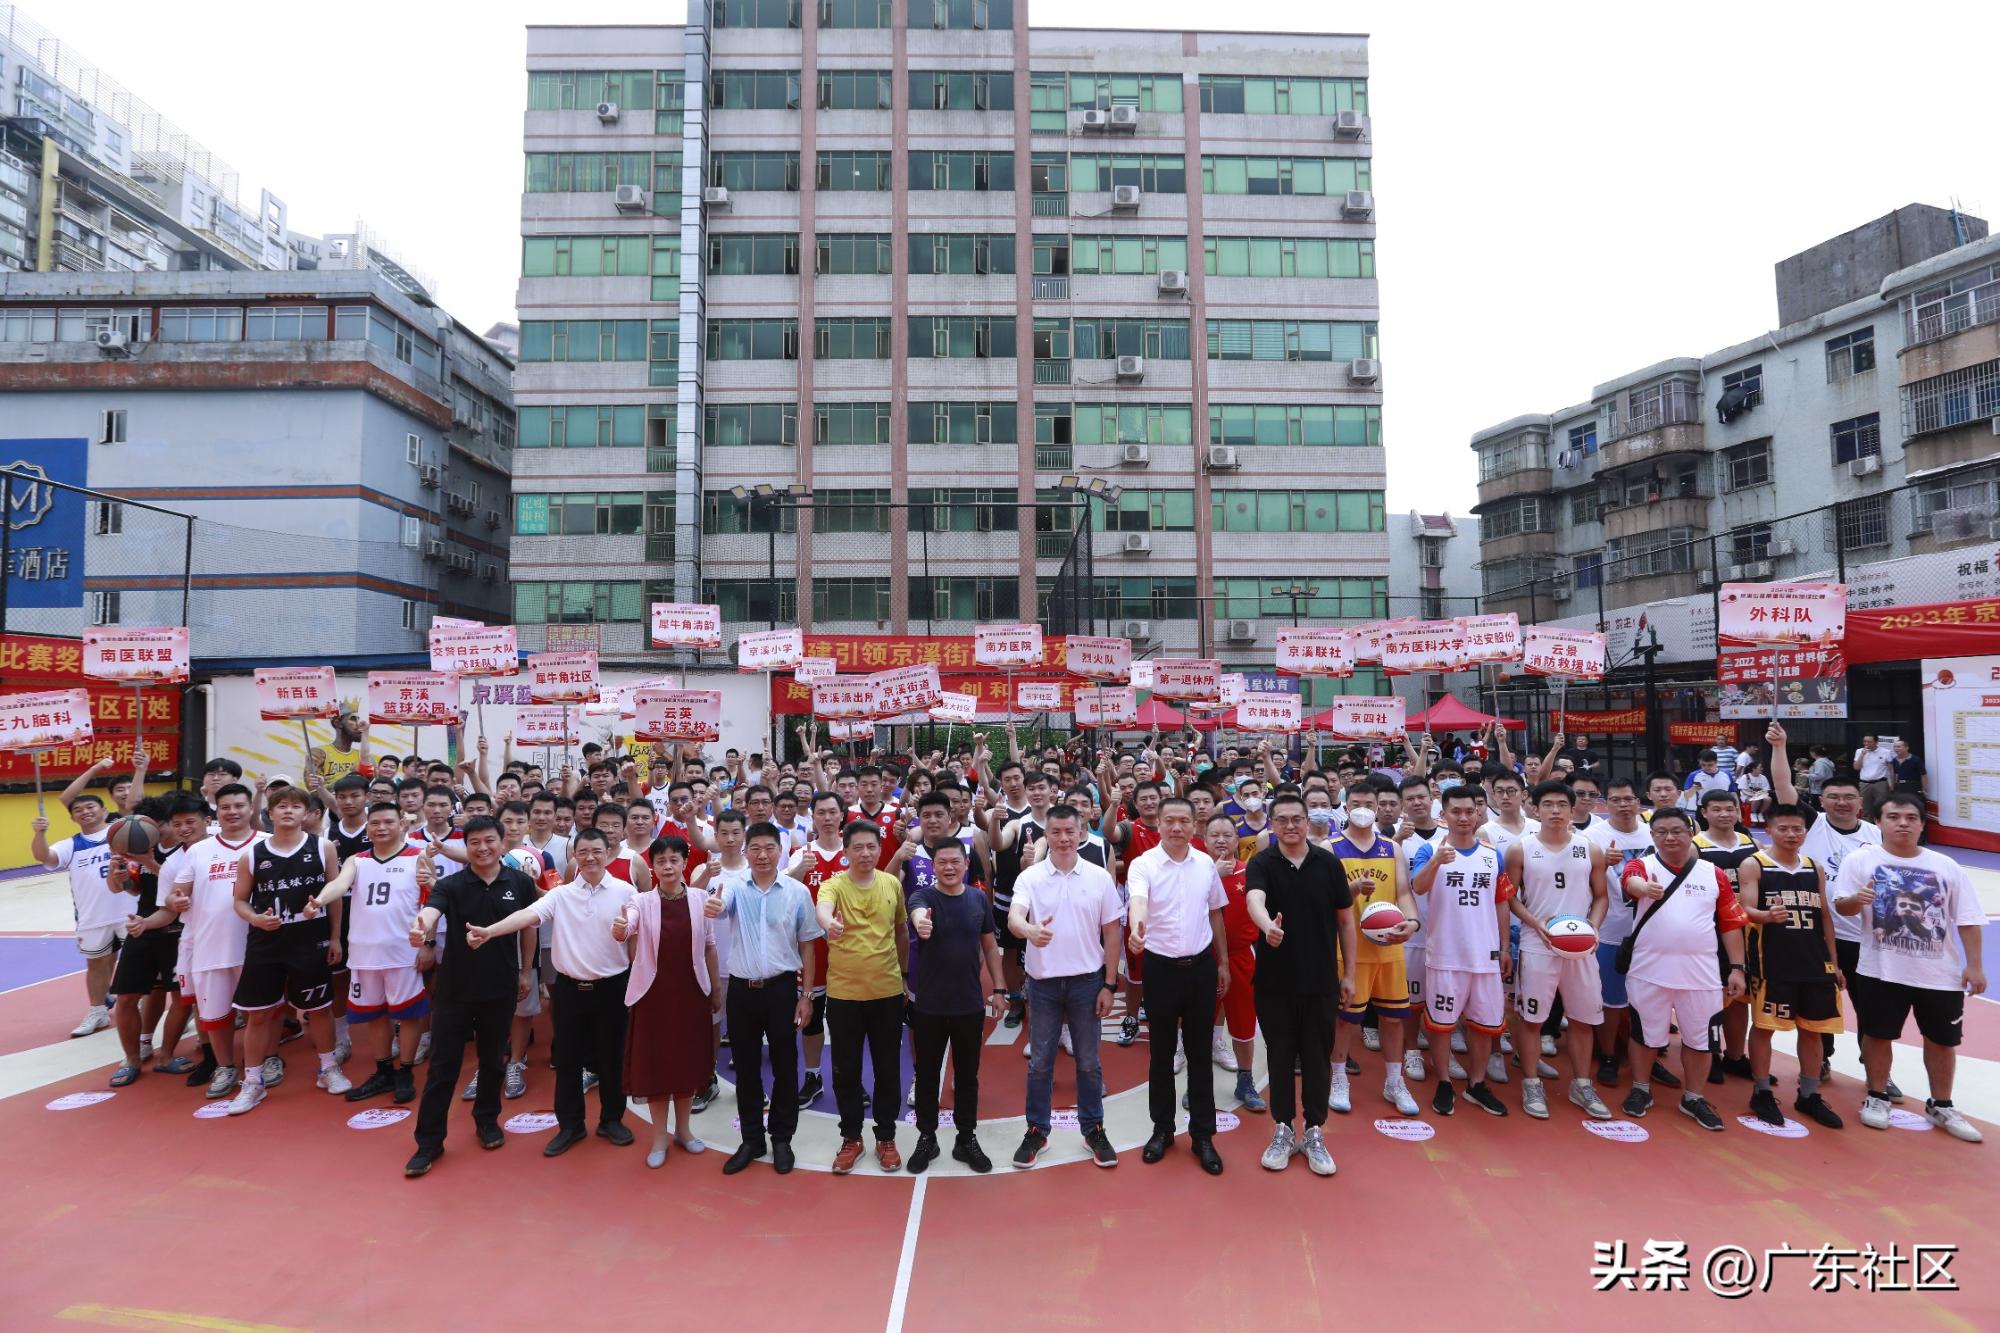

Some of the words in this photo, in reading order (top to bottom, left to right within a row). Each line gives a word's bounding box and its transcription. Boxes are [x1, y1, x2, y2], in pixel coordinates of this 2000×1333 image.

[1750, 606, 1812, 622] 外科队
[433, 644, 514, 656] 交警白云一大队
[749, 643, 793, 656] 京溪小学
[985, 640, 1032, 652] 南方医院
[1288, 645, 1341, 658] 京溪联社
[1386, 639, 1464, 654] 南方医科大学
[1552, 644, 1577, 657] 云景
[100, 649, 173, 662] 南医联盟
[1081, 653, 1115, 665] 烈火队
[1530, 654, 1598, 673] 消防救援站
[1159, 674, 1214, 686] 第一退休所
[276, 687, 318, 699] 新百佳
[399, 688, 430, 701] 京溪
[883, 680, 929, 697] 京溪街道
[879, 690, 938, 711] 机关工会队
[383, 701, 446, 715] 篮球公园
[664, 707, 692, 720] 云英
[1248, 708, 1291, 718] 农批市场
[1350, 712, 1387, 724] 京四社
[649, 720, 706, 734] 实验学校
[1446, 871, 1491, 889] 京溪
[1554, 872, 1566, 889] 9
[366, 882, 391, 906] 19
[1458, 890, 1480, 906] 25
[1785, 910, 1814, 929] 35
[302, 984, 328, 1001] 77
[1436, 994, 1454, 1012] 25
[1527, 998, 1538, 1015] 9
[1764, 1001, 1790, 1018] 35
